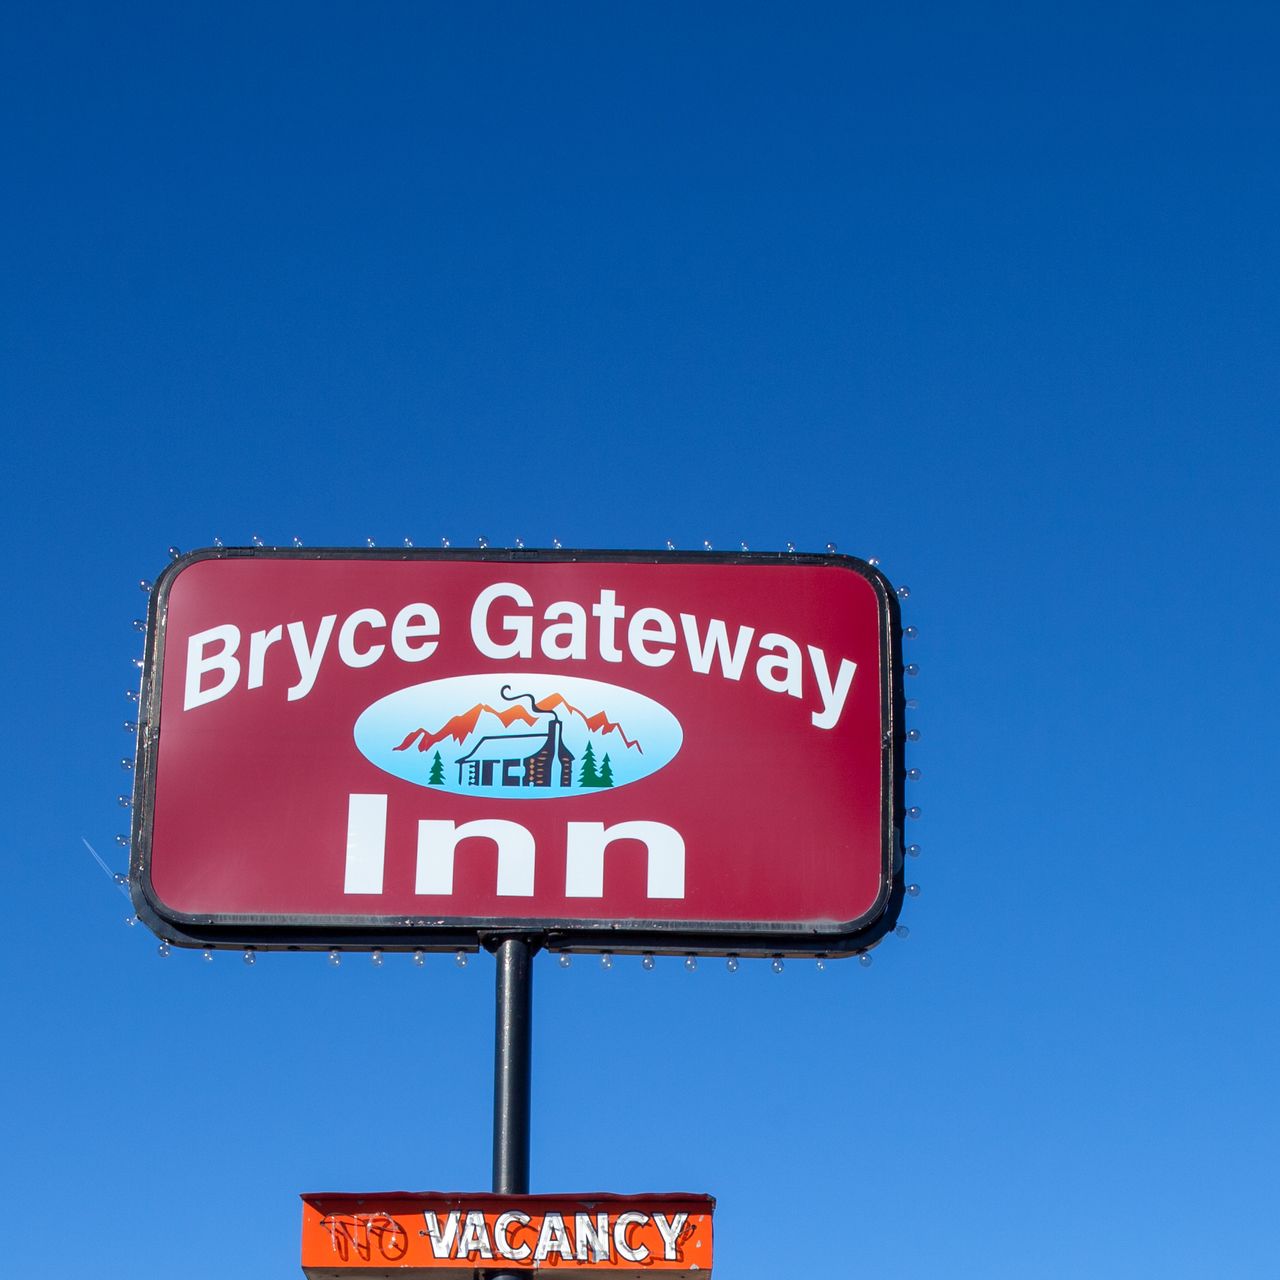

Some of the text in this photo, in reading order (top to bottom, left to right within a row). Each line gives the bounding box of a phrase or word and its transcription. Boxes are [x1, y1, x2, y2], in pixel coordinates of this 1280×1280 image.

[183, 582, 858, 730] Bryce Gateway
[343, 792, 686, 899] Inn
[322, 1210, 690, 1262] NO VACANCY
